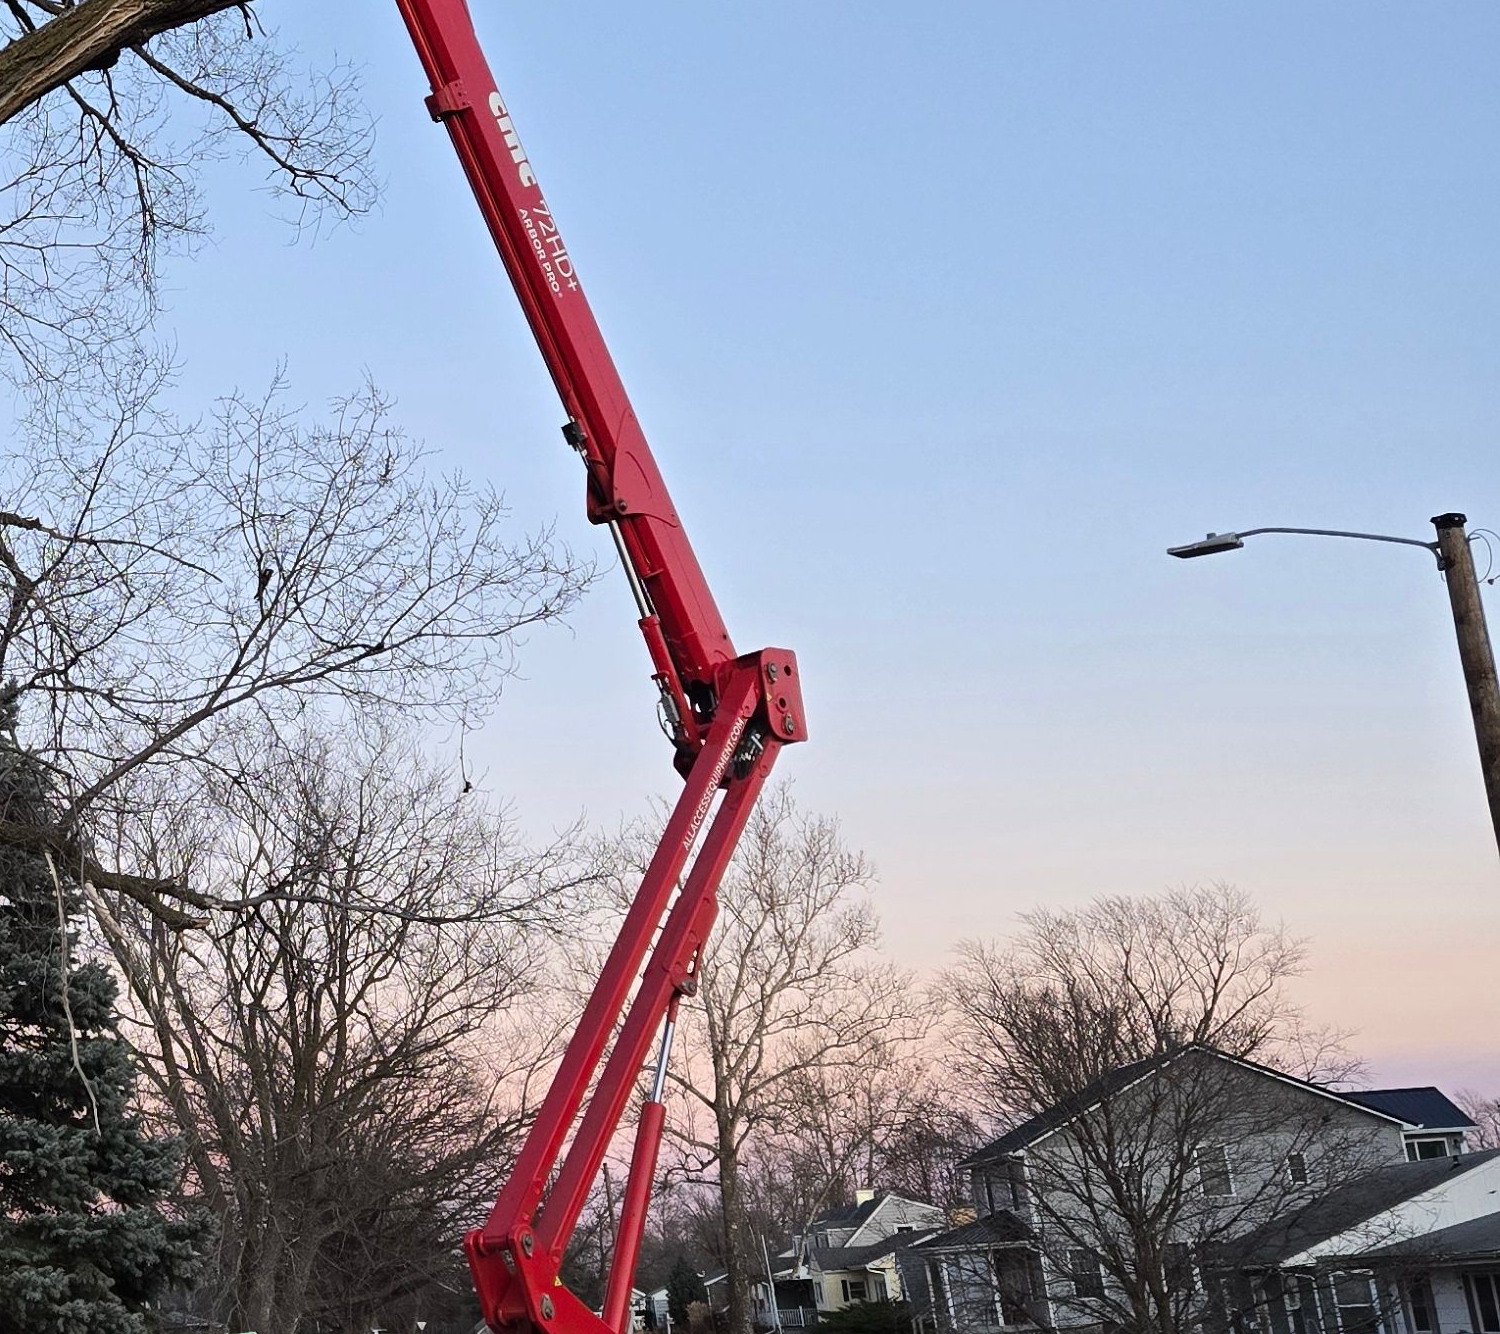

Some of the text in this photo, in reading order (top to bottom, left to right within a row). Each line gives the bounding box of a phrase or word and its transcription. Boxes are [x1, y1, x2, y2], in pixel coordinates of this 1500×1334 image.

[488, 91, 537, 187] cmc
[519, 208, 546, 260] ARBOR
[533, 199, 578, 292] 72HD+
[682, 717, 745, 851] ALLACCESSEQUIPMENT.COM
